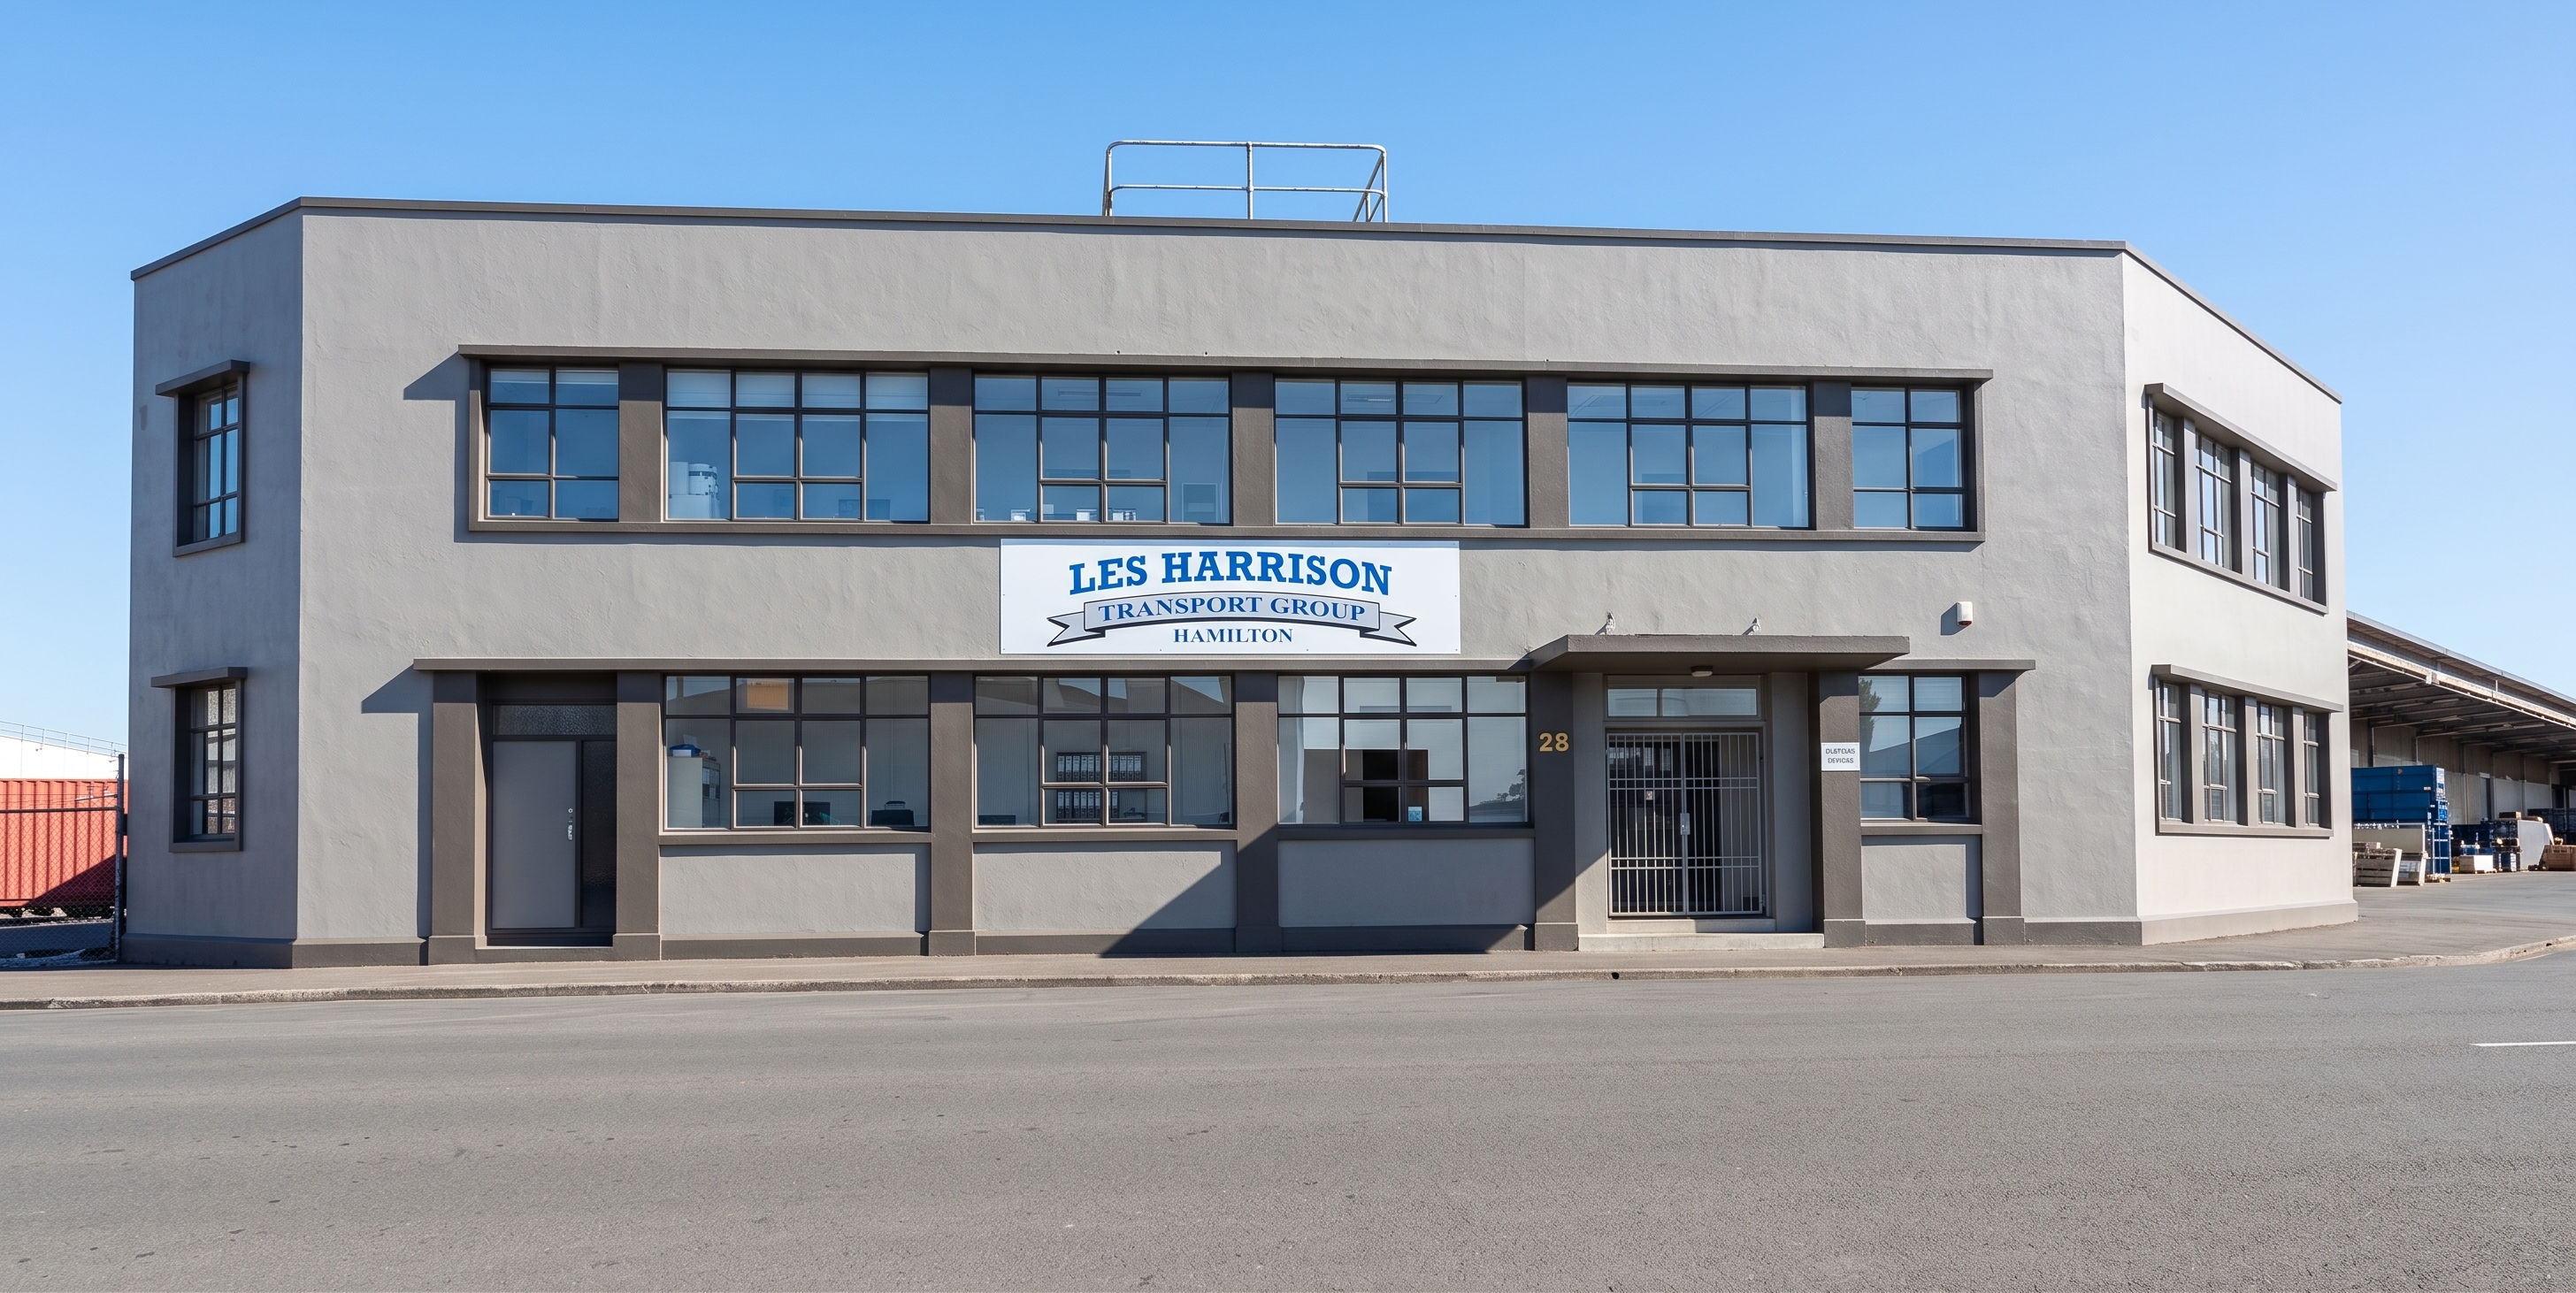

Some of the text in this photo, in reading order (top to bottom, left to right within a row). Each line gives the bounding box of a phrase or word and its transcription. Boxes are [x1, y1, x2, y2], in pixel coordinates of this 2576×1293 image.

[1069, 551, 1392, 596] LES HARRISON
[1097, 596, 1366, 622] TRANSPORT GROUP
[1173, 628, 1293, 643] HAMILTON
[1539, 732, 1569, 752] 28
